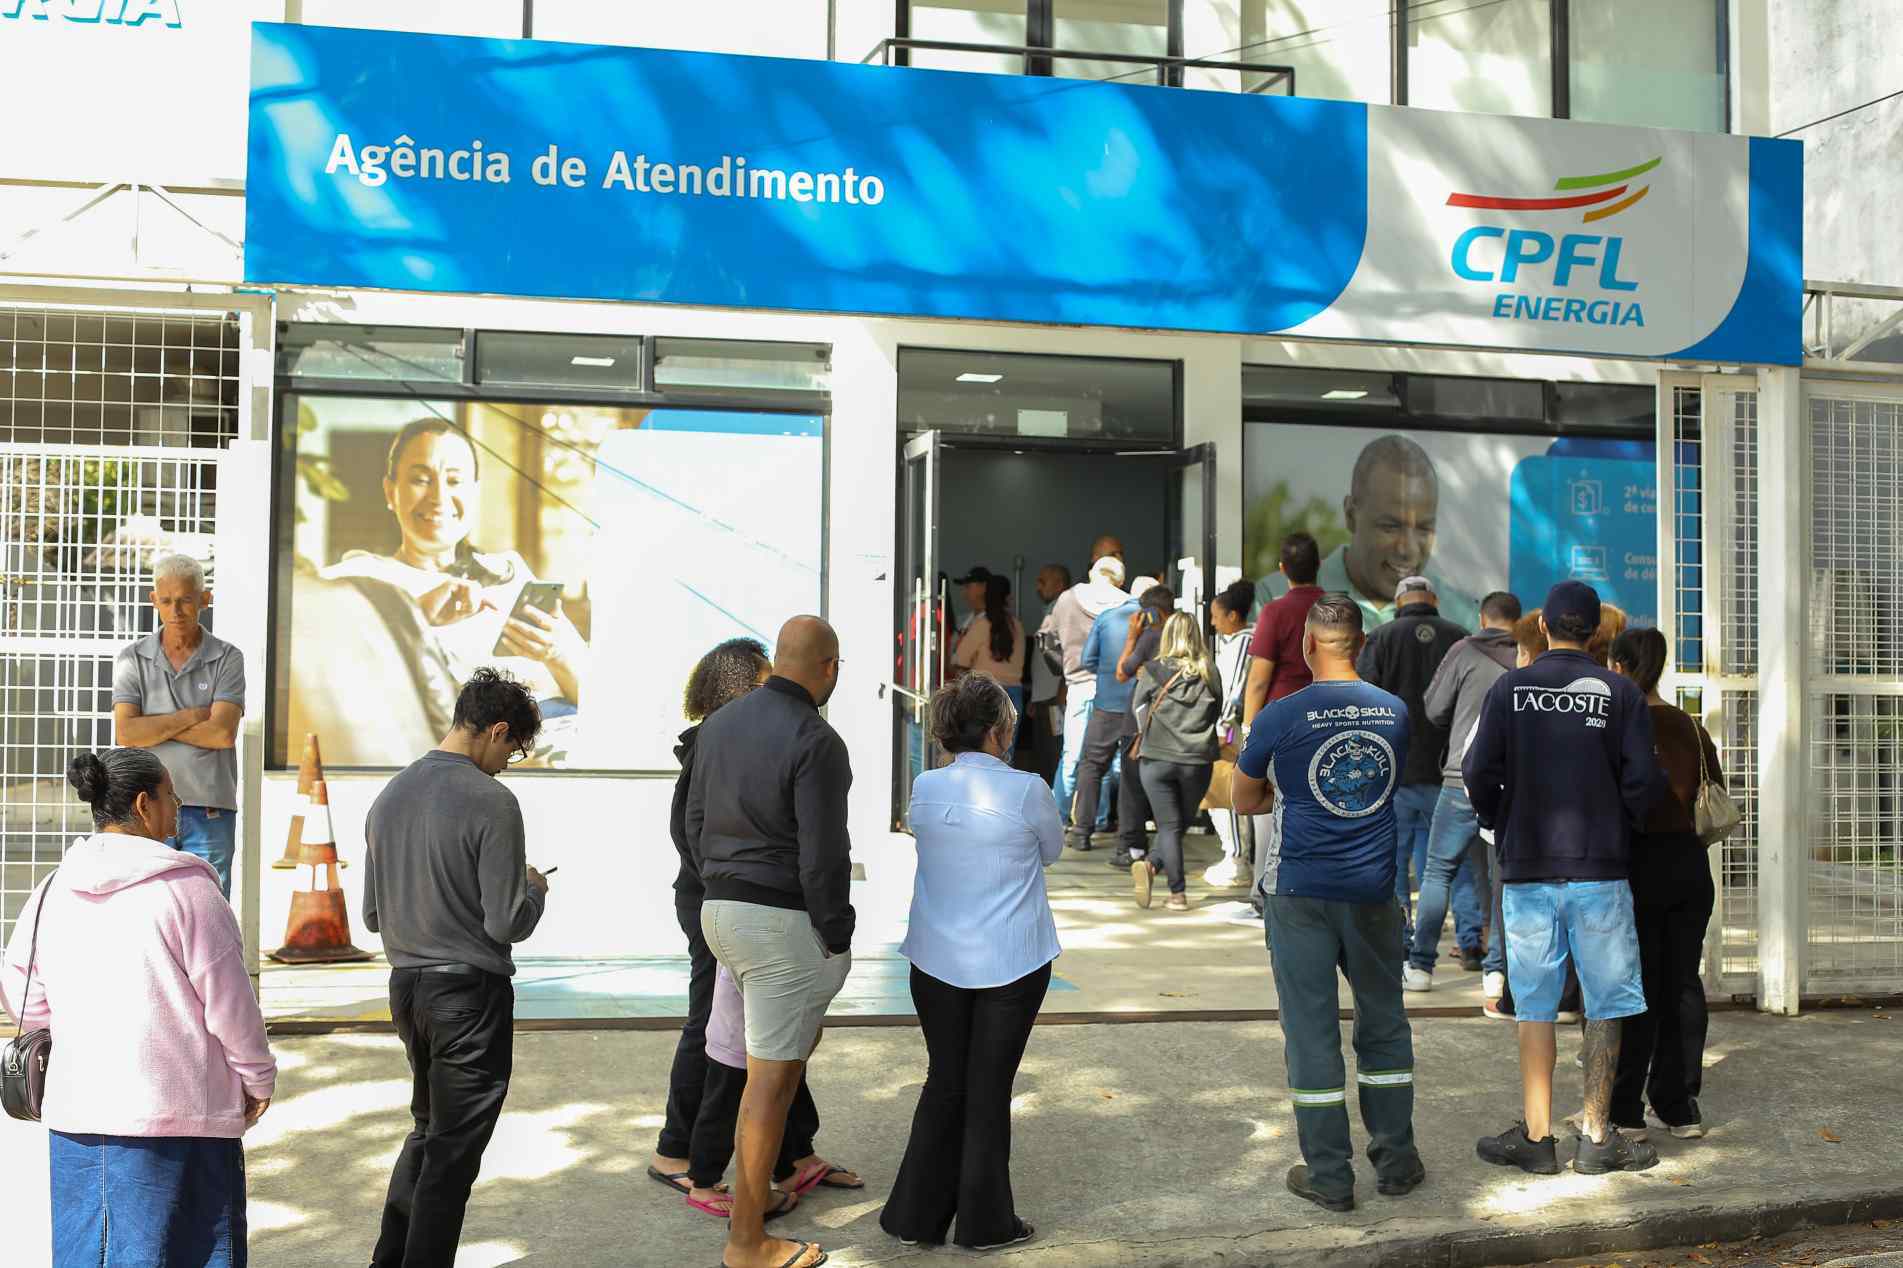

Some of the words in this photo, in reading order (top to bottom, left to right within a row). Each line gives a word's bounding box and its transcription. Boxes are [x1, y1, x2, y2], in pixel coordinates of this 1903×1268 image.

[324, 133, 511, 188] Agência
[531, 144, 587, 188] de
[602, 150, 886, 206] Atendimento
[1450, 225, 1639, 292] CPFL
[1492, 293, 1645, 327] ENERGIA
[1306, 708, 1346, 721] BLACK
[1360, 706, 1396, 718] SKULL
[1513, 691, 1611, 716] LACOSTE
